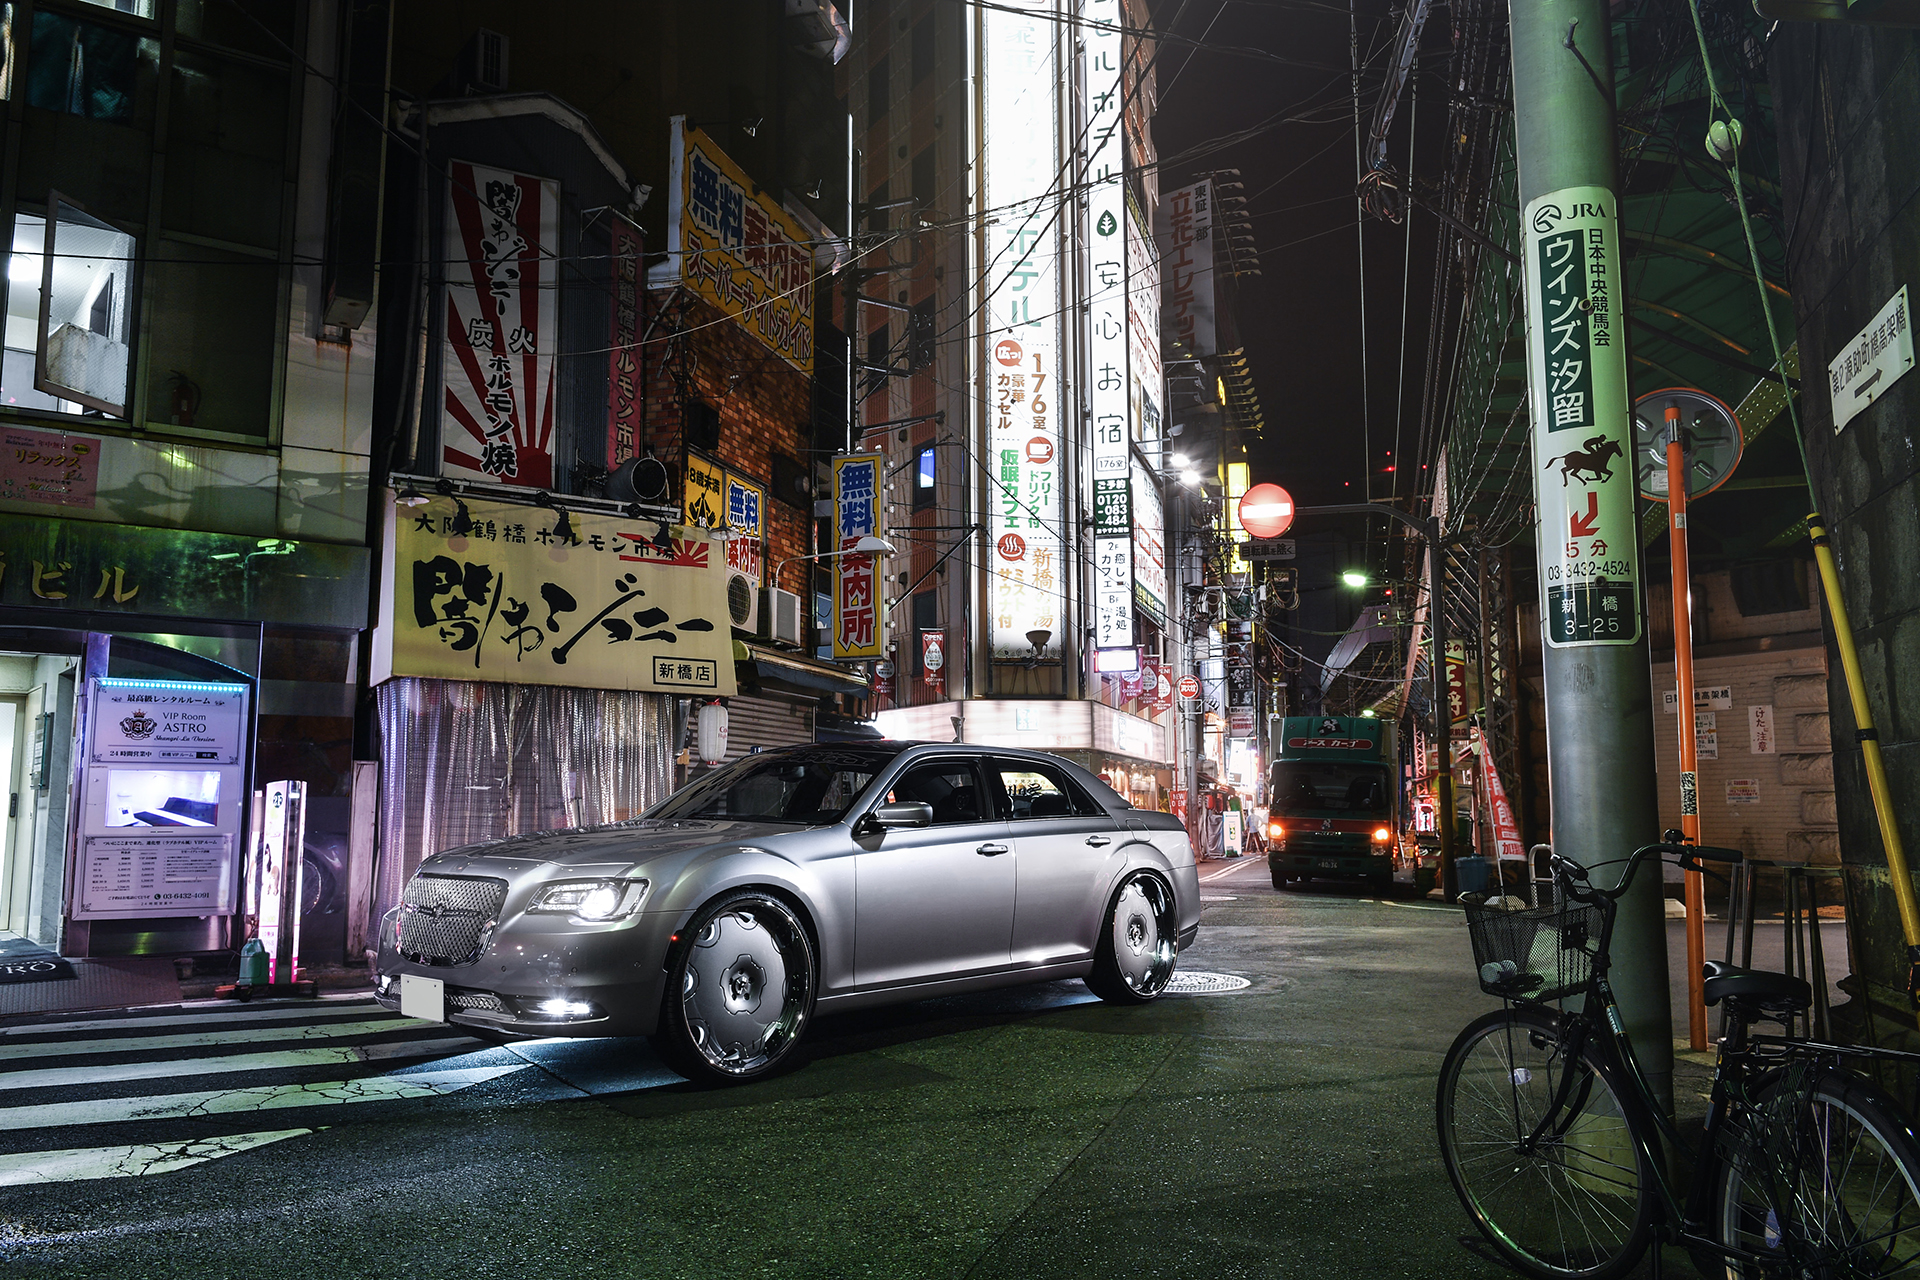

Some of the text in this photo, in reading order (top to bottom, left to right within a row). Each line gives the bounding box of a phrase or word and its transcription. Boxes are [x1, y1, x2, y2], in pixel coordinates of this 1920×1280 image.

[1093, 0, 1118, 184] セルホテル
[1194, 185, 1209, 242] 東証一部
[1567, 202, 1607, 219] JRA
[690, 146, 811, 317] 無料案内所
[686, 234, 811, 365] スーパーナイトガイド
[1588, 228, 1611, 347] 日本中央競馬会
[1546, 236, 1585, 427] ウインズ汐留
[1095, 260, 1124, 443] 安心お宿
[997, 373, 1013, 430] カプセル
[1012, 374, 1025, 402] 豪華
[1031, 353, 1047, 429] 176室
[482, 356, 517, 477] ホルモン焼
[15, 448, 82, 469] リラックス
[1099, 459, 1123, 469] 176室
[686, 467, 720, 496] 18歳未満
[1000, 449, 1019, 528] 仮眠カフェ
[1040, 471, 1052, 506] フリー
[1097, 480, 1127, 491] ご予約
[728, 482, 760, 534] 無料
[1028, 470, 1040, 529] ドリンク付
[1097, 493, 1127, 506] 0120
[1098, 505, 1127, 516] -083
[698, 516, 707, 528] 18
[1098, 515, 1127, 526] -484
[727, 535, 760, 580] 案内所
[839, 462, 876, 649] 無料案内所
[1108, 541, 1119, 551] 2F
[1241, 543, 1293, 557] 自転車を除く
[1566, 539, 1609, 558] 5分
[0, 550, 139, 604] ビル
[1101, 554, 1112, 588] カフェ
[1547, 560, 1631, 581] 03-3432-4524
[997, 567, 1013, 629] サウナ付
[1562, 595, 1618, 614] 新橋
[1564, 618, 1619, 636] 3-25
[658, 662, 711, 682] 新橋店
[127, 694, 211, 704] 最高級レンタルルーム
[162, 712, 207, 721] VIP Room
[162, 723, 207, 734] ASTRO
